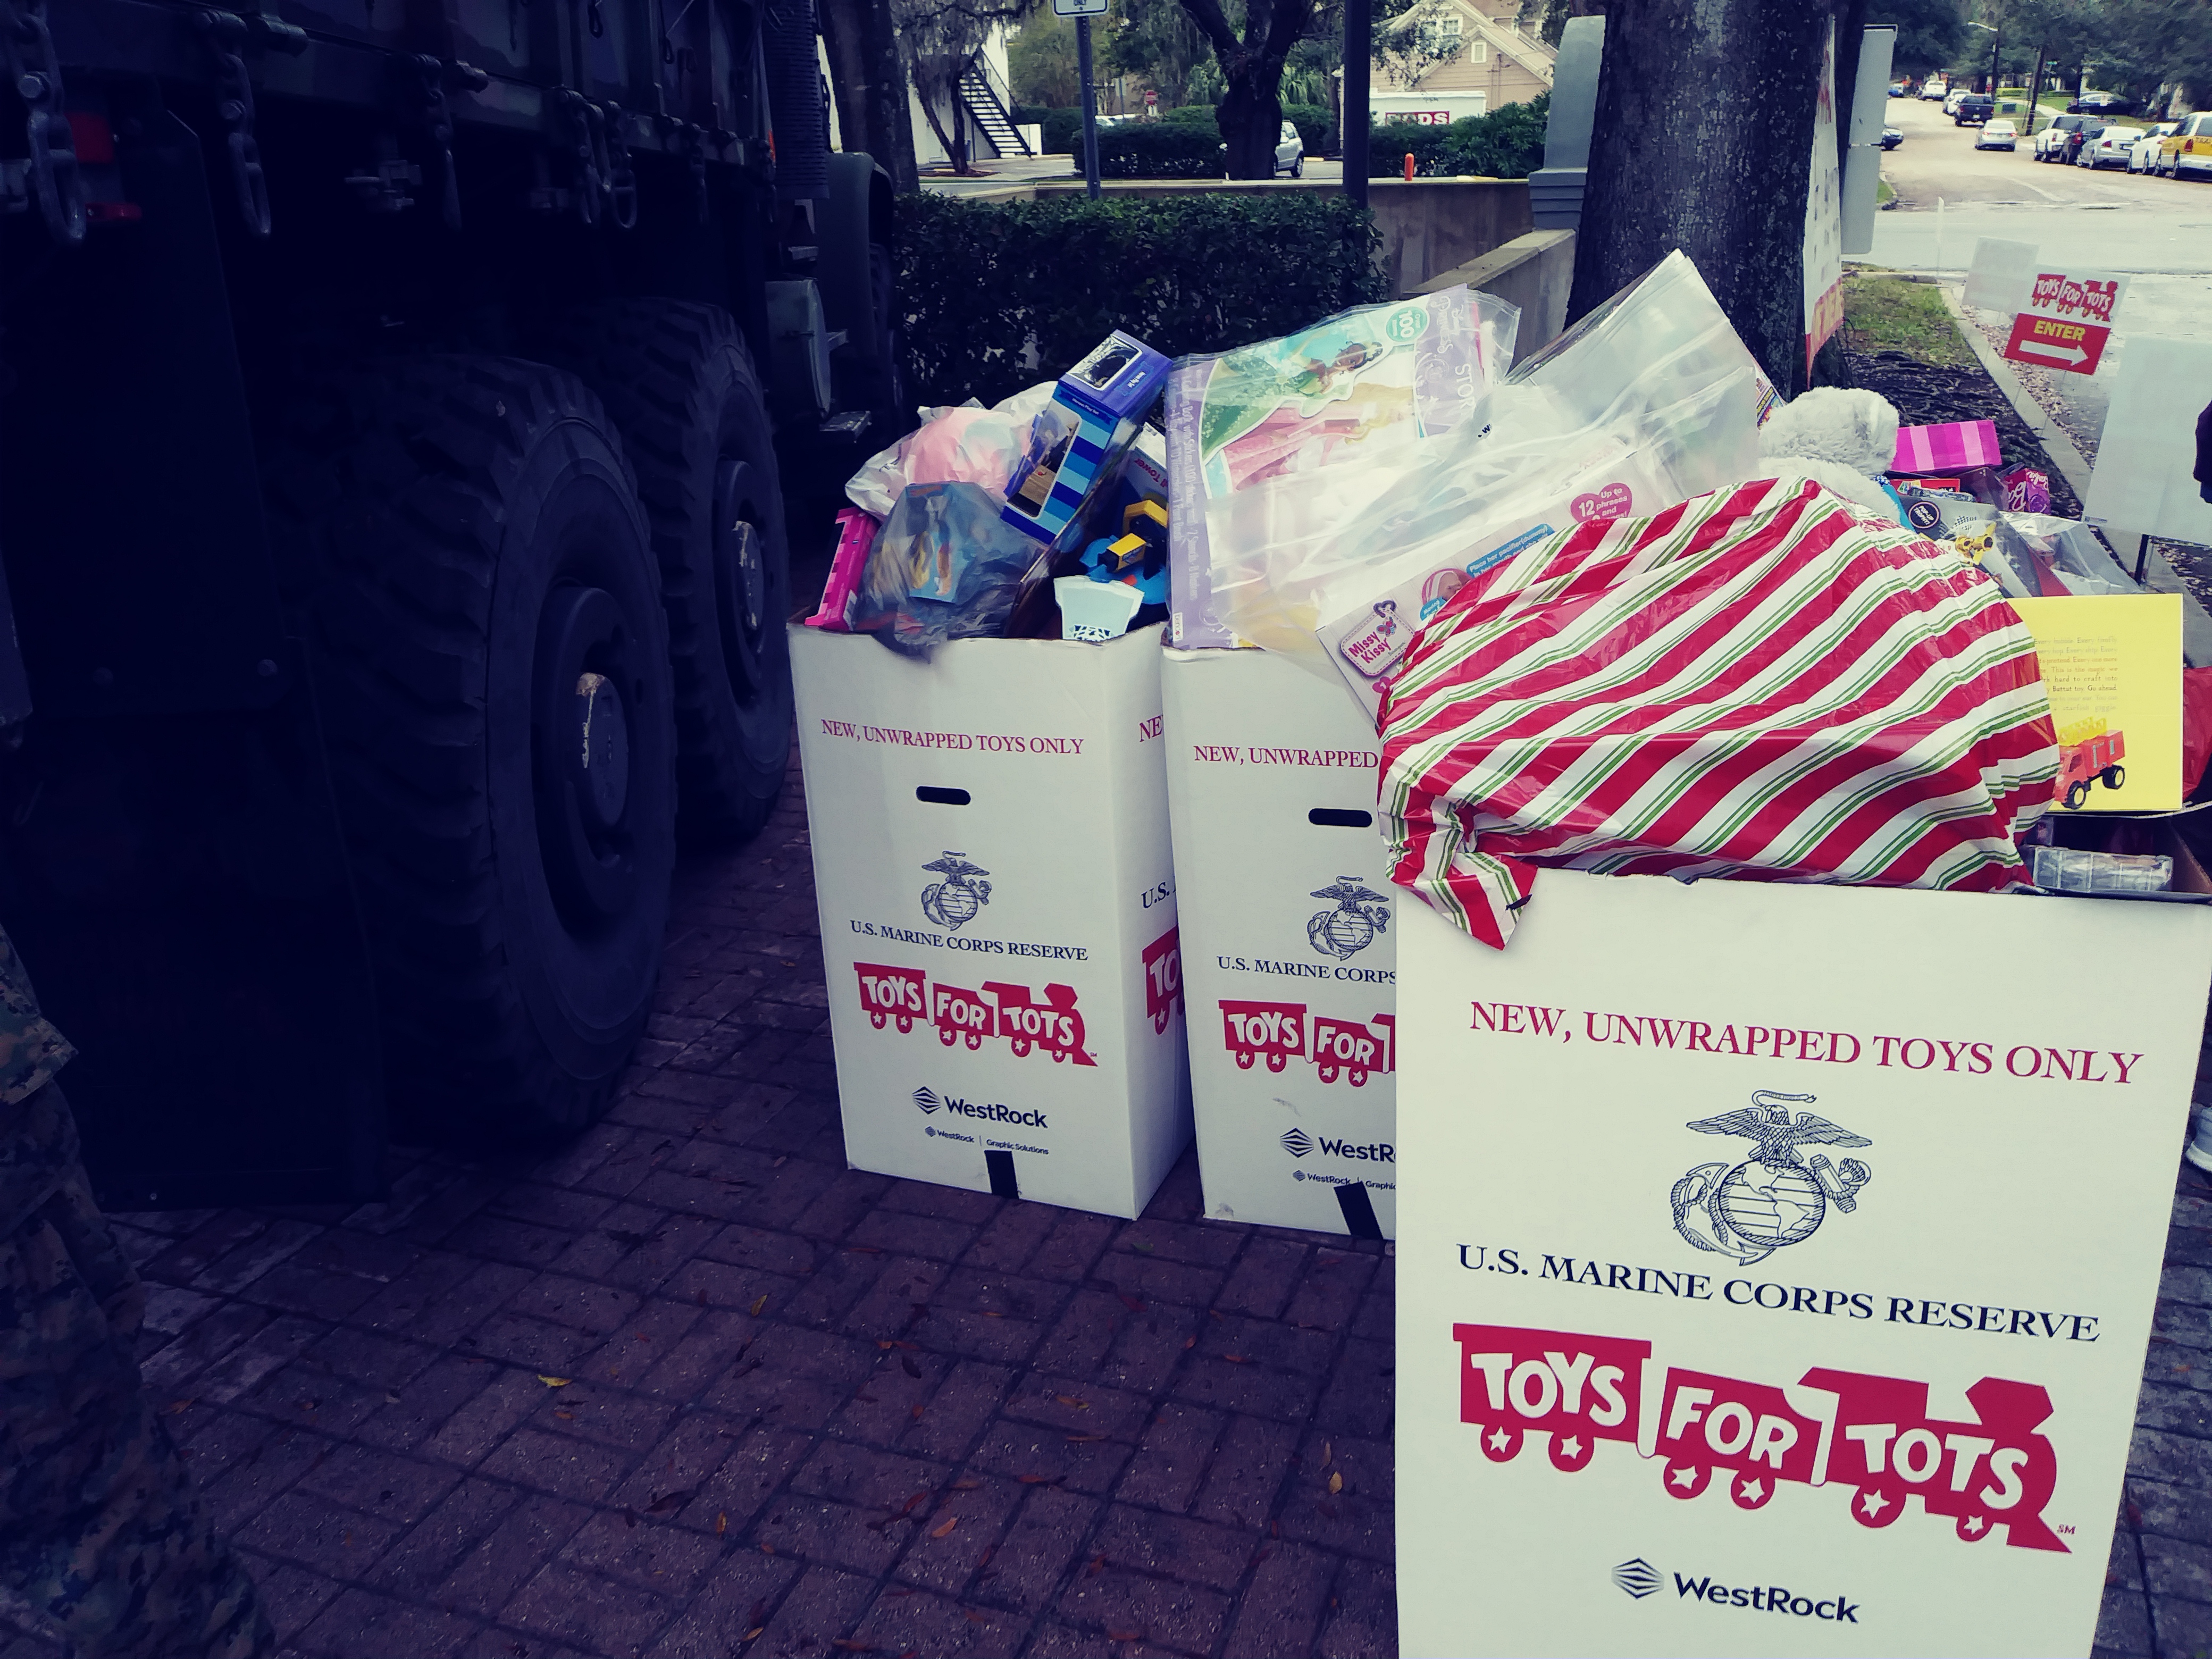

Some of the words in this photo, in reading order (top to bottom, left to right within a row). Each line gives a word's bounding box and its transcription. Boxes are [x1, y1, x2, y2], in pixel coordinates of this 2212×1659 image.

[2038, 279, 2060, 296] TOYS
[2062, 285, 2080, 304] FOR
[2087, 292, 2111, 312] TOTS
[1398, 309, 1415, 338] 100
[2034, 320, 2085, 341] ENTER
[1596, 495, 1628, 510] phrases
[1614, 488, 1622, 496] to
[1579, 499, 1595, 517] 12
[1602, 506, 1617, 516] and
[1918, 506, 1934, 521] POP-UP
[1487, 553, 1498, 563] her
[1348, 631, 1380, 657] Missy
[1361, 637, 1392, 664] Kissy
[821, 719, 860, 741] NEW,
[862, 725, 973, 749] UNWRAPPED
[976, 735, 1025, 752] TOYS
[1030, 738, 1084, 753] ONLY
[1139, 715, 1163, 742] NE
[1193, 746, 1244, 765] NEW,
[1249, 748, 1378, 768] UNWRAPPED
[1141, 882, 1169, 908] U.S.
[850, 920, 877, 935] U.S.
[881, 925, 943, 947] MARINE
[946, 937, 1003, 953] CORPS
[1007, 942, 1088, 960] RESERVE
[1217, 956, 1250, 971] U.S.
[1254, 959, 1330, 978] MARINE
[862, 975, 922, 1011] TOYS
[936, 993, 986, 1029] FOR
[1002, 1006, 1074, 1046] TOTS
[1227, 1011, 1299, 1048] TOYS
[1317, 1025, 1375, 1066] FOR
[1470, 1001, 1571, 1043] NEW,
[1583, 1011, 1861, 1063] UNWRAPPED
[1873, 1036, 1993, 1074] TOYS
[2006, 1046, 2144, 1084] ONLY
[944, 1095, 1048, 1128] WestRock
[937, 1129, 974, 1143] WestRock
[986, 1138, 1014, 1150] Graphic
[1015, 1143, 1049, 1155] Solutions
[1318, 1136, 1395, 1163] WestR
[1307, 1173, 1351, 1184] WestRock
[1456, 1244, 1528, 1275] U.S.
[1538, 1254, 1713, 1300] MARINE
[1724, 1280, 1873, 1319] CORPS
[1884, 1296, 2100, 1342] RESERVE
[1471, 1351, 1627, 1427] TOYS
[1666, 1385, 1798, 1469] FOR
[1845, 1423, 2029, 1511] TOTS
[2057, 1524, 2076, 1535] SM
[1673, 1572, 1860, 1624] WestRock
